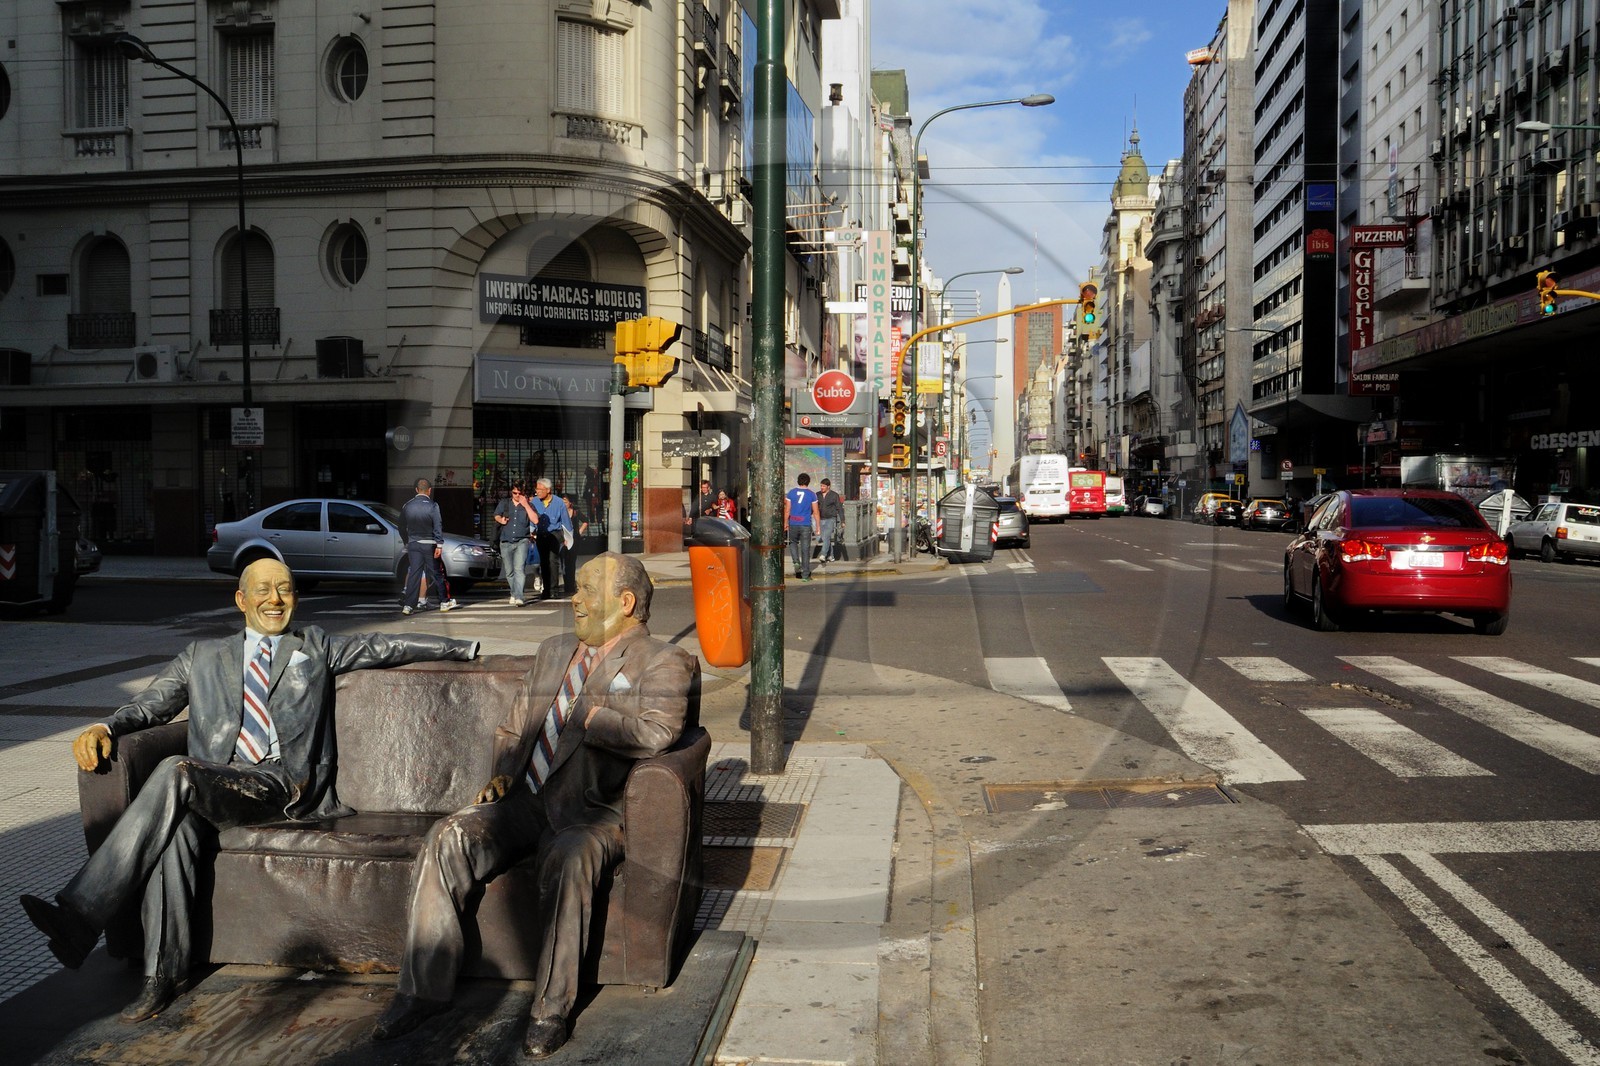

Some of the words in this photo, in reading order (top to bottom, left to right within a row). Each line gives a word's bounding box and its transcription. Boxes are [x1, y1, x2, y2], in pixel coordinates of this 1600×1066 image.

[1354, 230, 1404, 243] PIZZERIA
[1312, 240, 1329, 249] ibis
[485, 279, 537, 301] INVENTOS
[542, 285, 589, 305] MARCAS
[595, 289, 642, 309] MODELOS
[485, 301, 522, 316] INFORMES
[523, 305, 542, 319] AQUI
[543, 306, 589, 321] CORRIENTES
[872, 236, 886, 389] INMORTALES
[1372, 373, 1399, 381] FAMILIAR
[816, 386, 852, 398] Subte
[1375, 383, 1391, 391] PISO
[820, 415, 848, 423] Uruguay
[1236, 475, 1243, 484] 4
[1559, 469, 1570, 486] 79
[796, 491, 805, 504] 7
